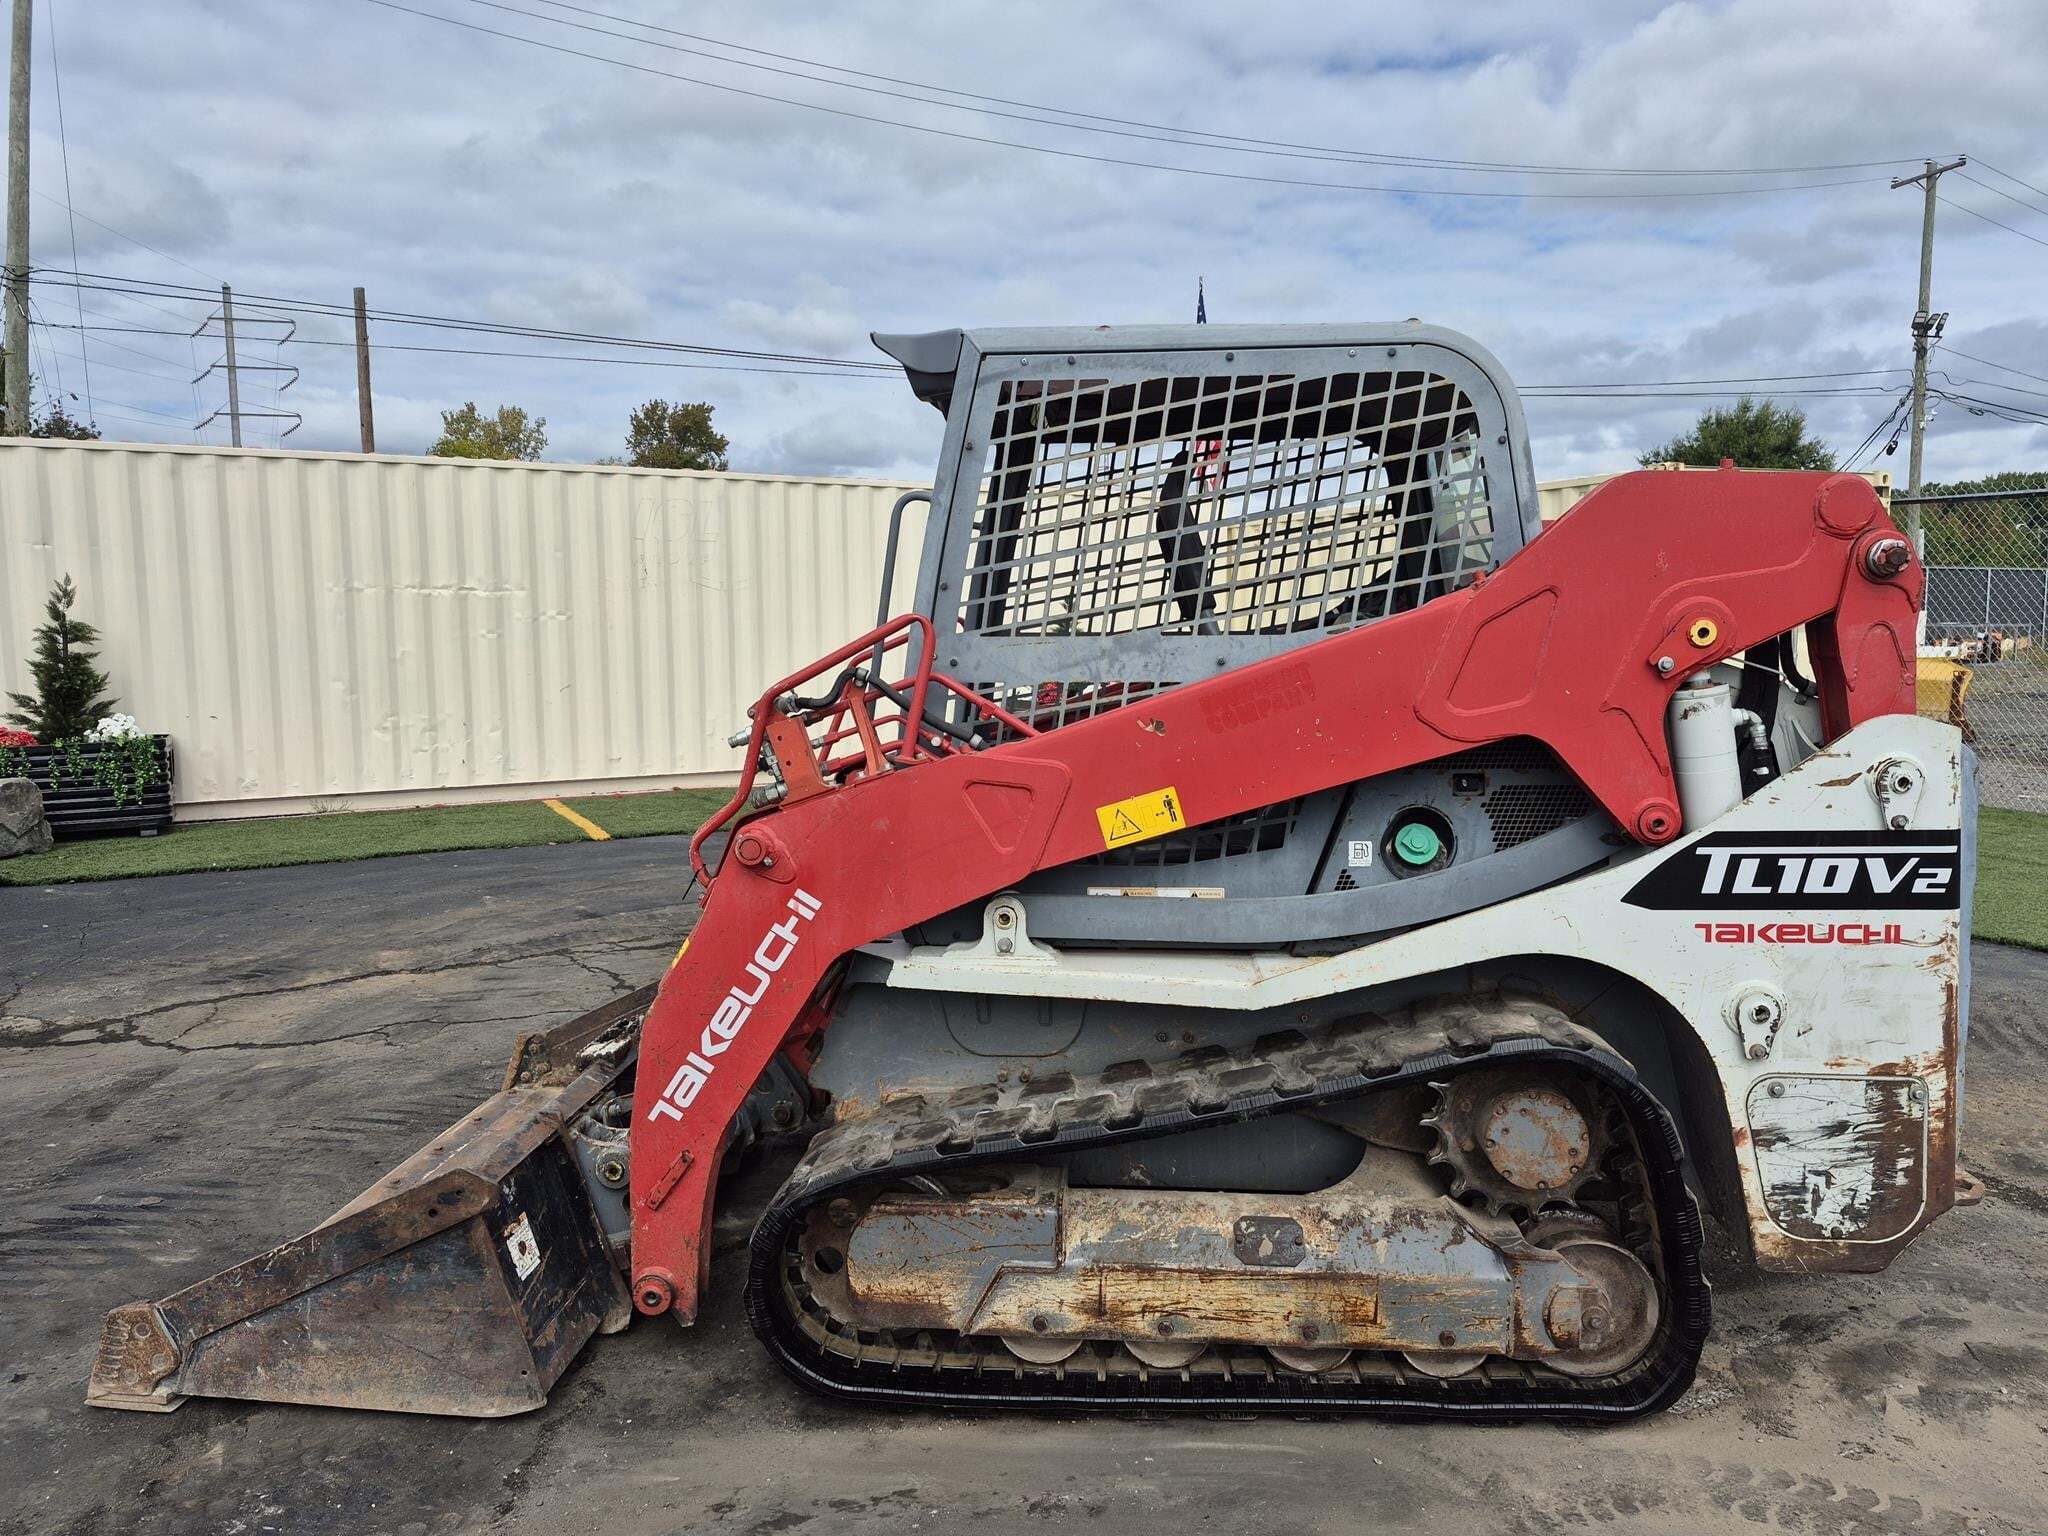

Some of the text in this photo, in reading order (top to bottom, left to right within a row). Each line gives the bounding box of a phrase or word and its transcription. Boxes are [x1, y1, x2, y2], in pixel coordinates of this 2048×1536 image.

[1695, 845, 1958, 894] TL10V2
[1694, 923, 1903, 944] TAKEUCHI
[647, 888, 822, 1122] TAKEUCHI
